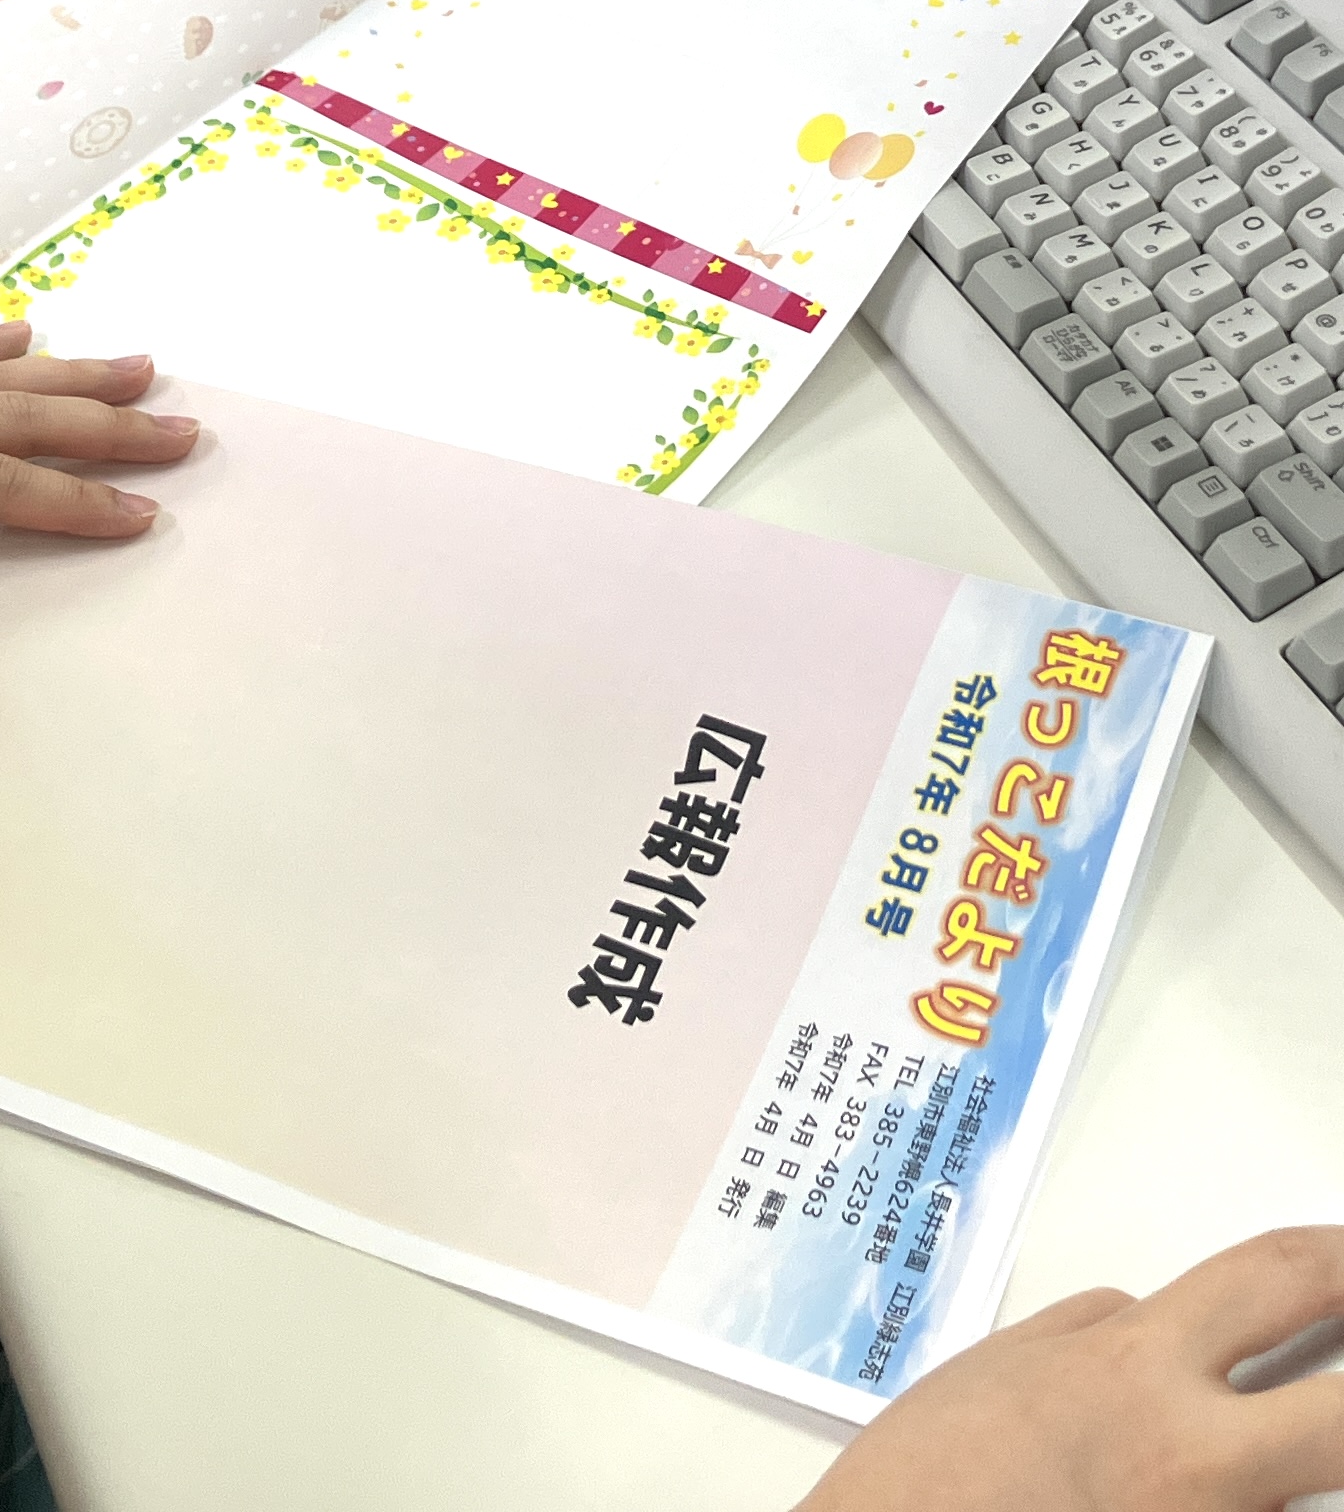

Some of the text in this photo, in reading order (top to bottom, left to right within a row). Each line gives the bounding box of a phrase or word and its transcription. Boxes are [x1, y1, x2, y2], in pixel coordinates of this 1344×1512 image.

[1100, 12, 1119, 26] 5
[1269, 6, 1290, 20] F5
[1139, 49, 1158, 62] 6
[1312, 42, 1334, 58] F6
[1080, 56, 1102, 70] T
[1176, 85, 1198, 98] 7
[1031, 101, 1054, 115] G
[1118, 94, 1141, 108] Y
[1220, 125, 1240, 139] 8
[1068, 139, 1093, 154] H
[1157, 134, 1181, 148] U
[991, 153, 1014, 165] B
[1261, 165, 1282, 178] 9
[1197, 173, 1219, 185] I
[1108, 180, 1130, 193] J
[1030, 192, 1054, 206] N
[1305, 206, 1326, 220] 0
[1147, 219, 1174, 234] K
[1242, 216, 1265, 231] O
[1069, 233, 1095, 248] M
[1190, 262, 1211, 276] L
[1285, 257, 1309, 270] P
[1315, 313, 1337, 328] @
[1293, 461, 1326, 492] Shift
[1252, 526, 1279, 549] Ctrl
[864, 674, 997, 938] 令和7年 8月号
[909, 628, 1126, 1049] 根っこだより
[567, 713, 767, 1026] 広報作成
[857, 1041, 889, 1088] FAX
[893, 1055, 925, 1090] TEL
[718, 1022, 819, 1219] 令和7年 4月 日 発行
[752, 1033, 853, 1231] 令和7年 4月 日 編集
[864, 1062, 959, 1265] 江別市東野幌624番地
[904, 1074, 997, 1273] 社会福祉法人長井学園
